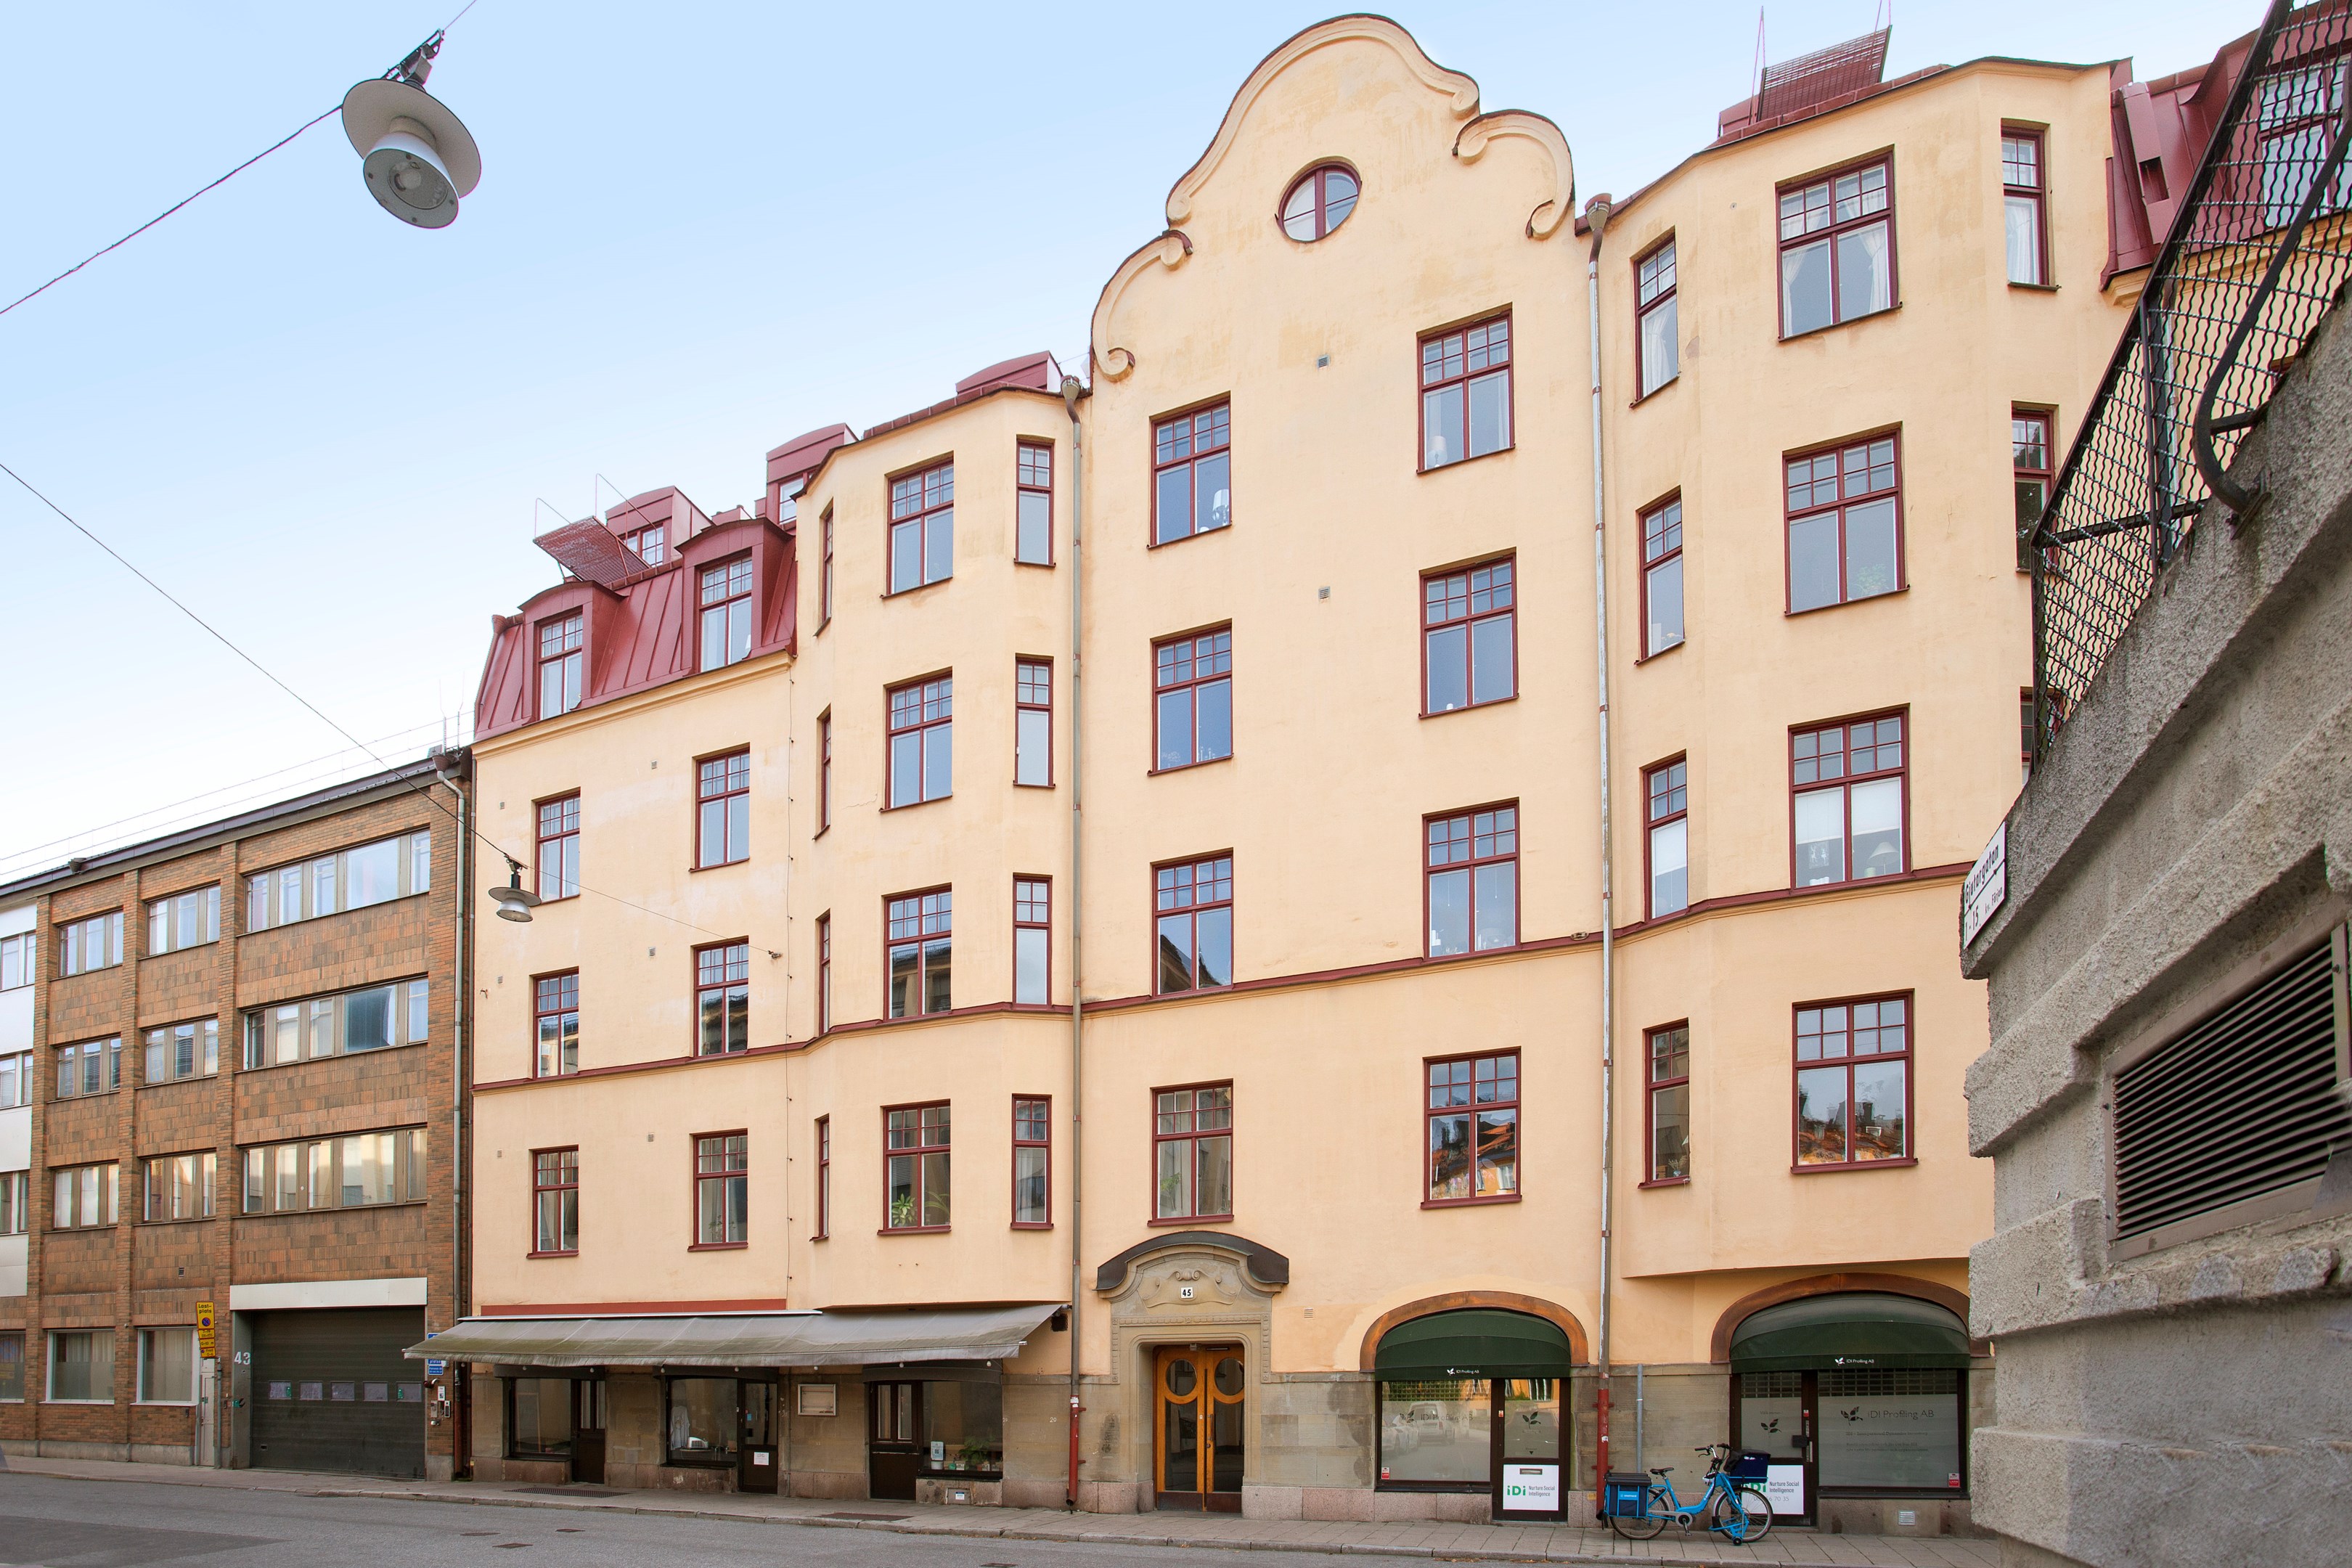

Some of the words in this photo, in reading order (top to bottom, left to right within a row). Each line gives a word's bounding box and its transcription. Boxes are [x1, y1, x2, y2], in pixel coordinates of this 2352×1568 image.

[1966, 845, 1998, 907] Gjutargatan
[234, 1351, 251, 1365] 43
[1433, 1413, 1460, 1423] Profiling
[1868, 1410, 1881, 1418] IDI
[1883, 1410, 1919, 1420] Profiling
[1920, 1409, 1934, 1418] AB
